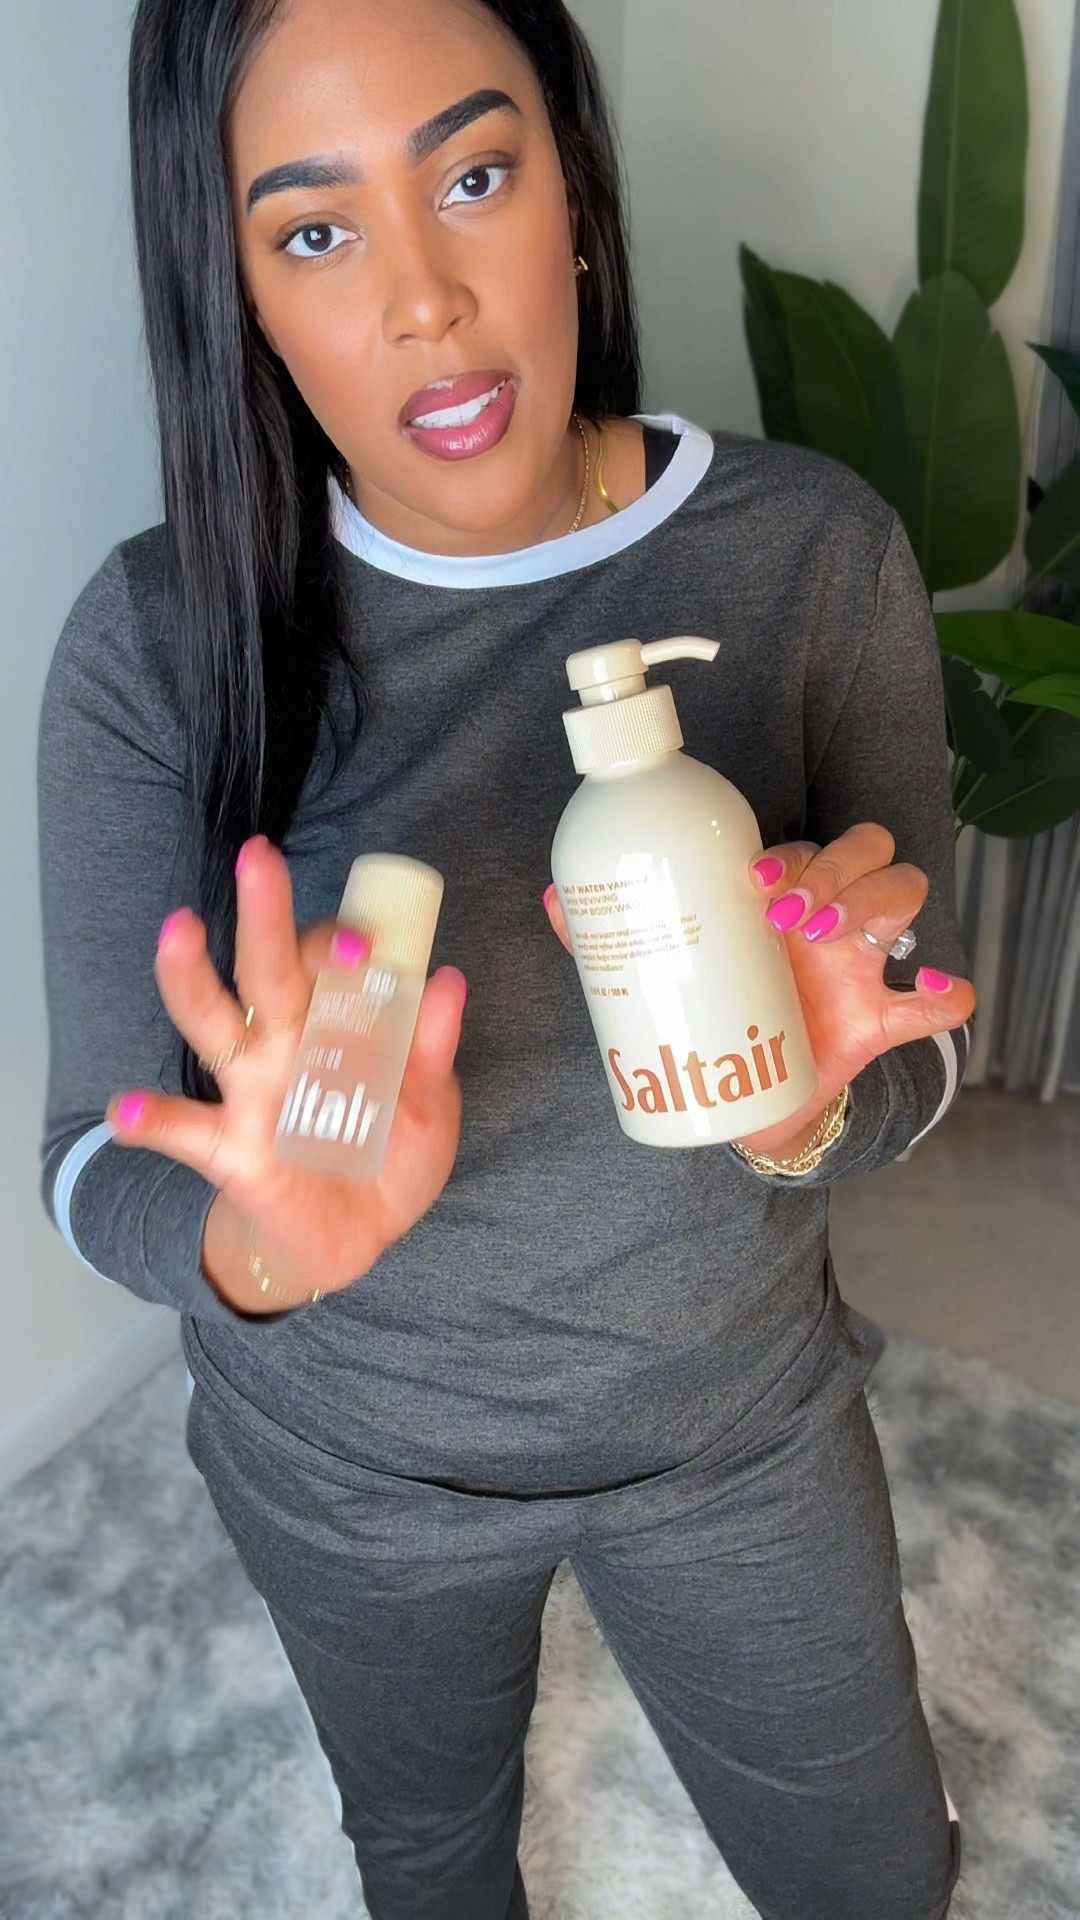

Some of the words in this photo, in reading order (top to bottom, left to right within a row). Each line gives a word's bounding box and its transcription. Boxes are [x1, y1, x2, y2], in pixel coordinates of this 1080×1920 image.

[577, 883, 606, 894] WATER
[578, 893, 618, 905] REVIVING
[589, 905, 613, 916] BODY
[608, 1025, 788, 1114] Saltair
